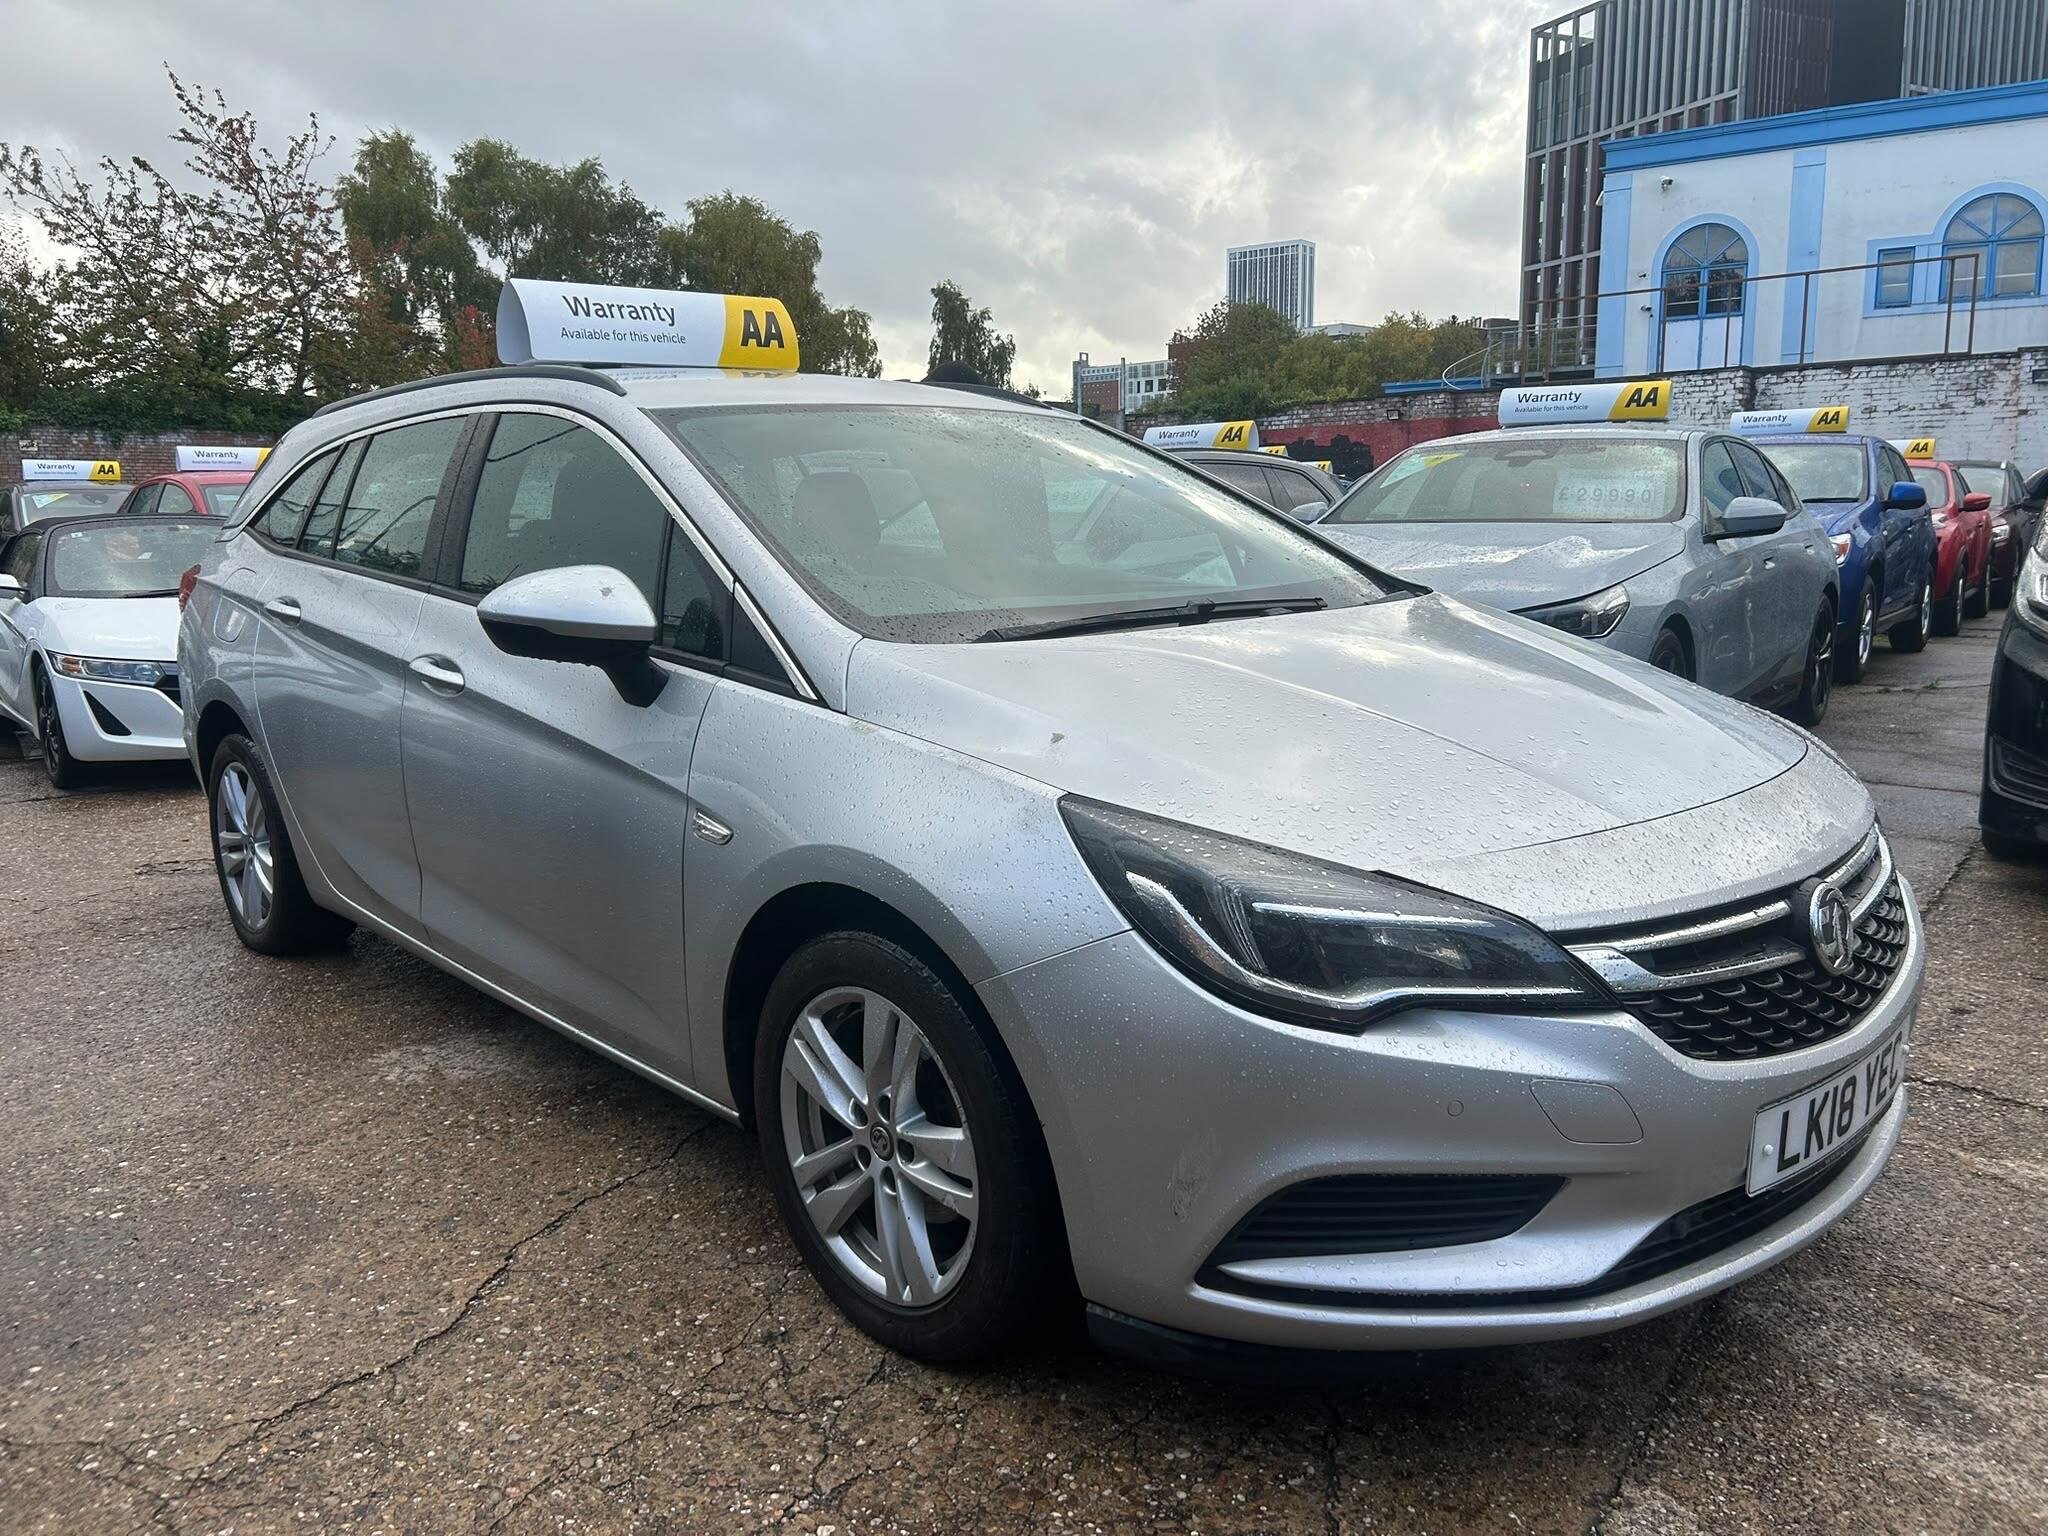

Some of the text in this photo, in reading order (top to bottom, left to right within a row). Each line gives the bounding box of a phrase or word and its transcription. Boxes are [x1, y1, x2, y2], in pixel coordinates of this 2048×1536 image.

[561, 294, 676, 327] Warranty
[560, 326, 687, 345] Available for this vehicle
[740, 309, 785, 349] AA
[1517, 390, 1582, 404] Warranty
[1624, 386, 1659, 408] AA
[1566, 403, 1589, 411] vehicle
[1742, 413, 1788, 424] Warranty
[1816, 410, 1841, 425] AA
[1158, 428, 1200, 440] Warranty
[1221, 425, 1244, 442] AA
[1910, 441, 1929, 453] AA
[194, 449, 239, 460] Warranty
[37, 462, 76, 471] Warranty
[97, 464, 115, 475] AA
[1776, 1074, 1858, 1173] LK18
[1865, 1031, 1903, 1117] YEC
